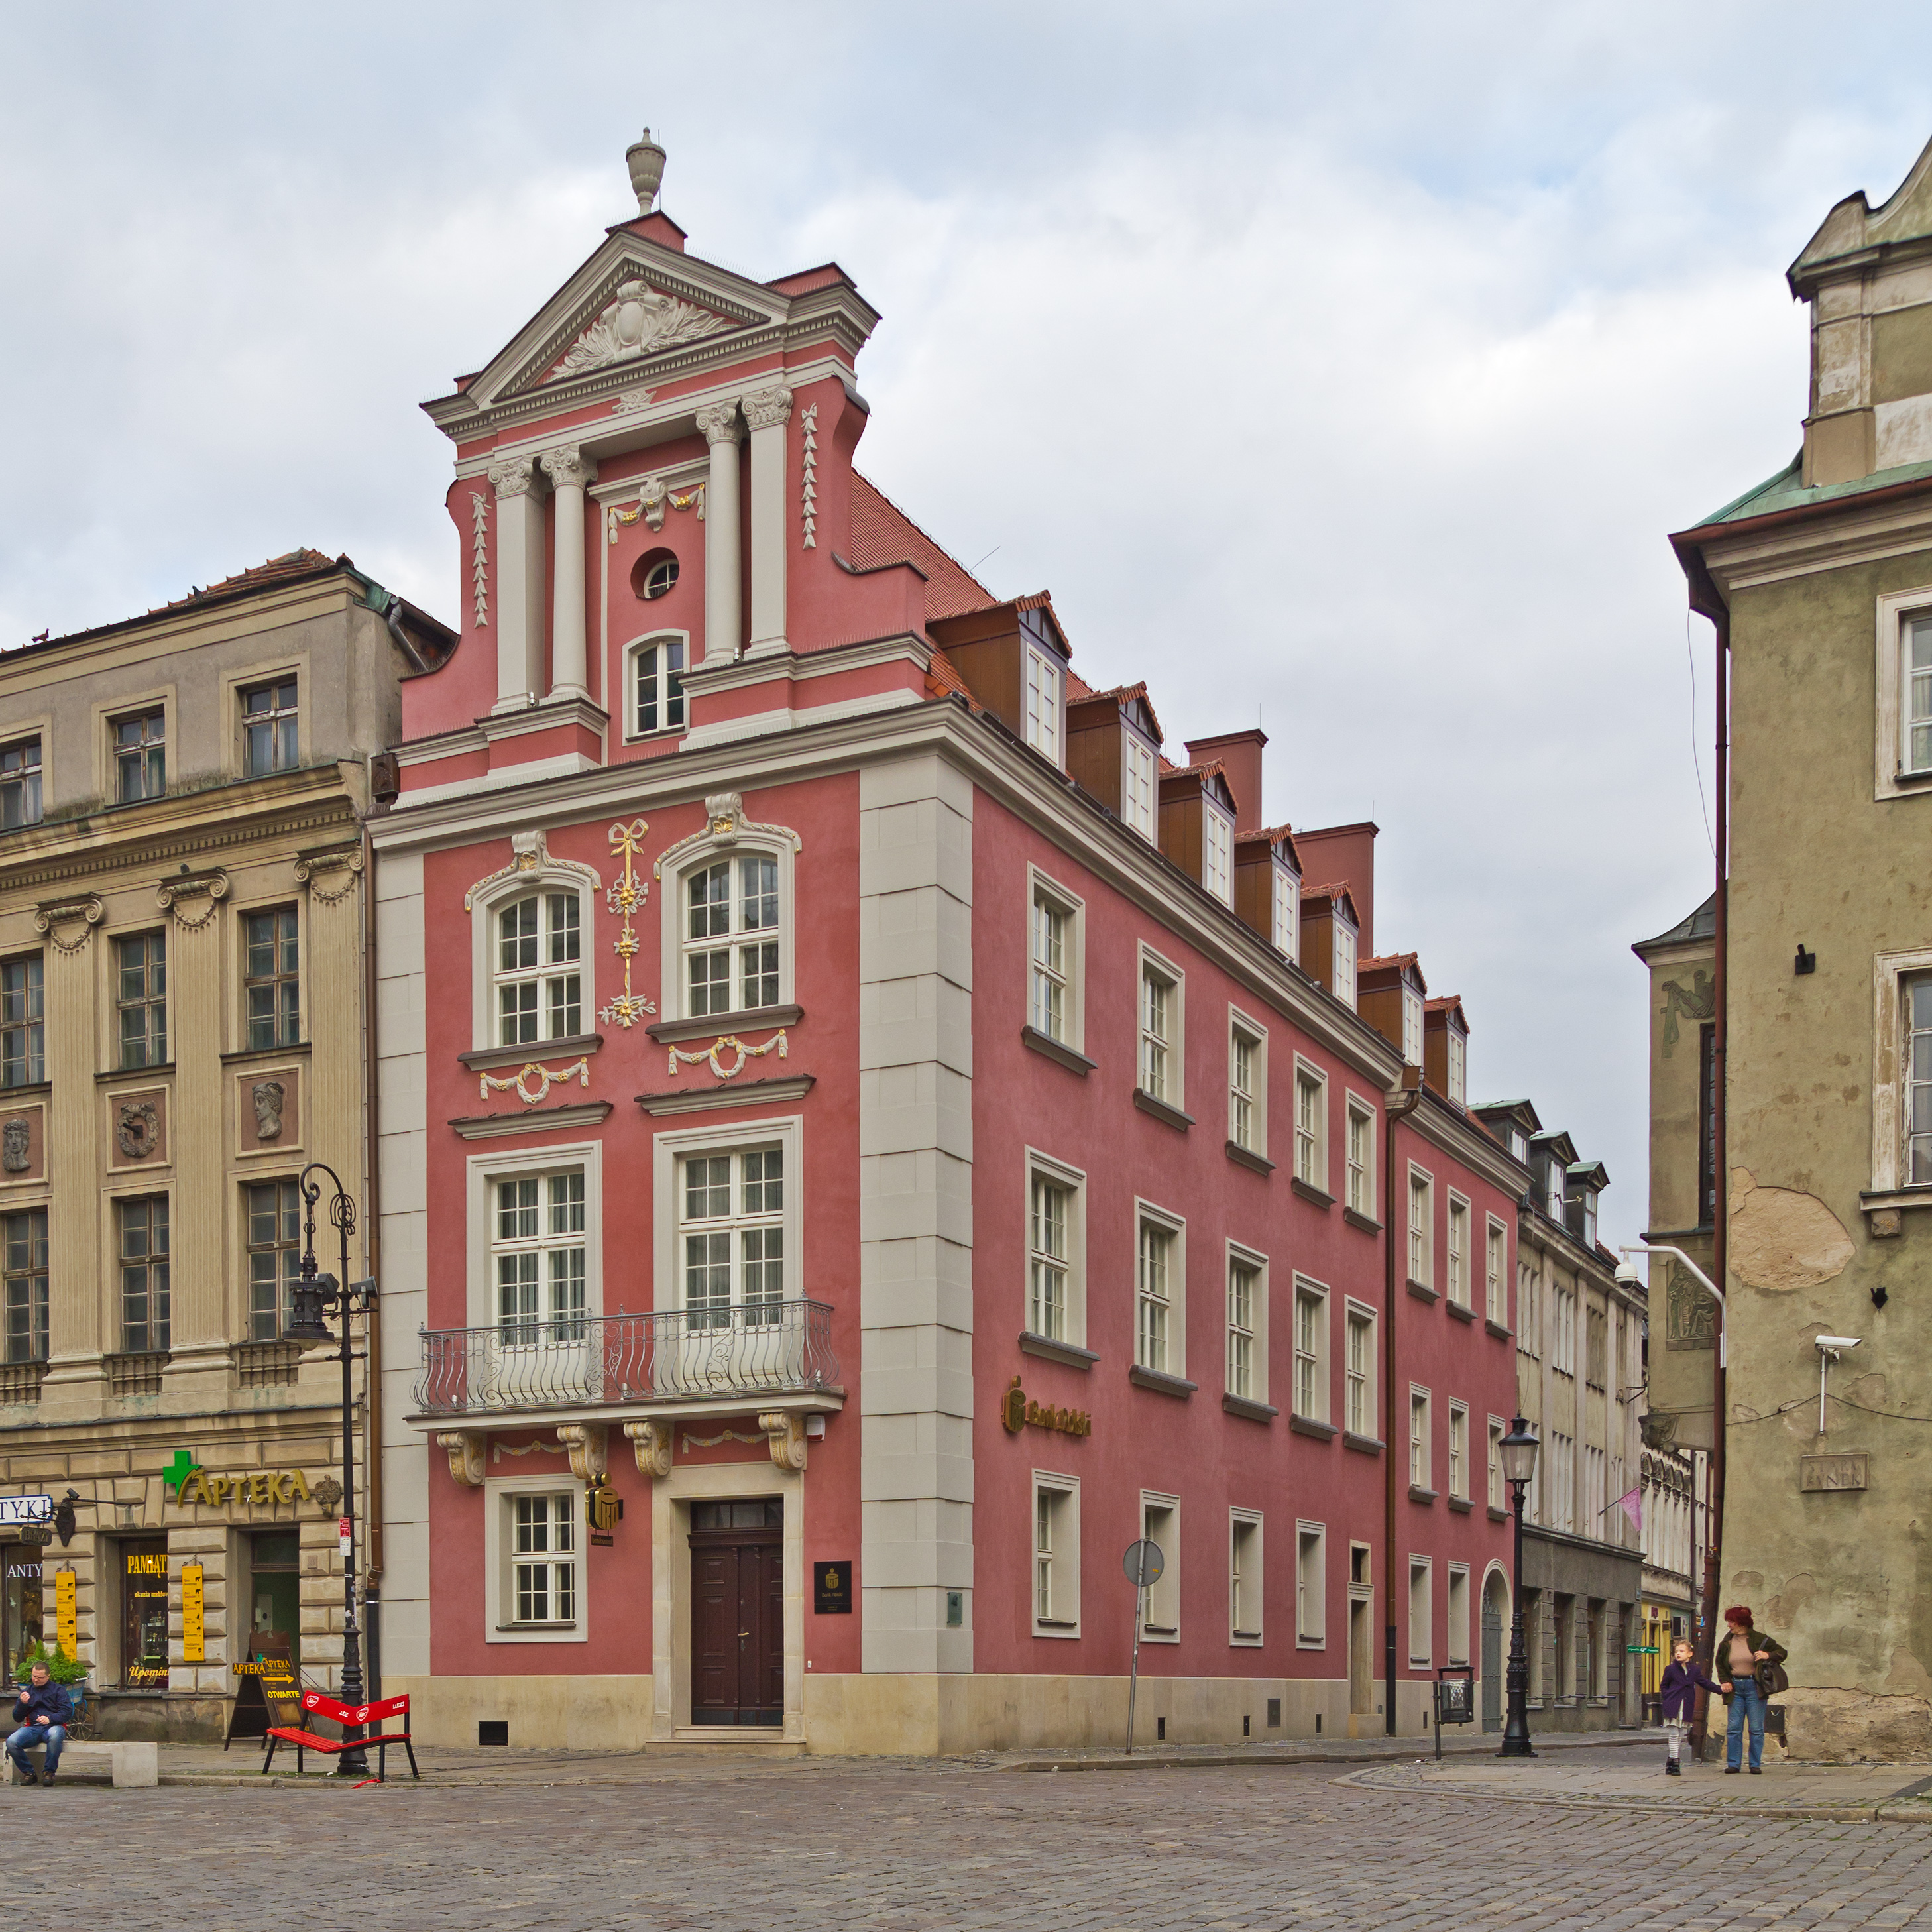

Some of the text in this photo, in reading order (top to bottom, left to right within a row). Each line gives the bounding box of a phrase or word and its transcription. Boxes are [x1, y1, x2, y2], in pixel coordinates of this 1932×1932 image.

[178, 1469, 310, 1508] APTEKA
[7, 1564, 42, 1577] ANTY
[127, 1554, 168, 1578] PAMIĄT
[233, 1662, 266, 1674] APTEKA
[261, 1658, 291, 1669] APTEKA
[129, 1666, 168, 1680] Upomin
[267, 1690, 300, 1699] OTWARTE
